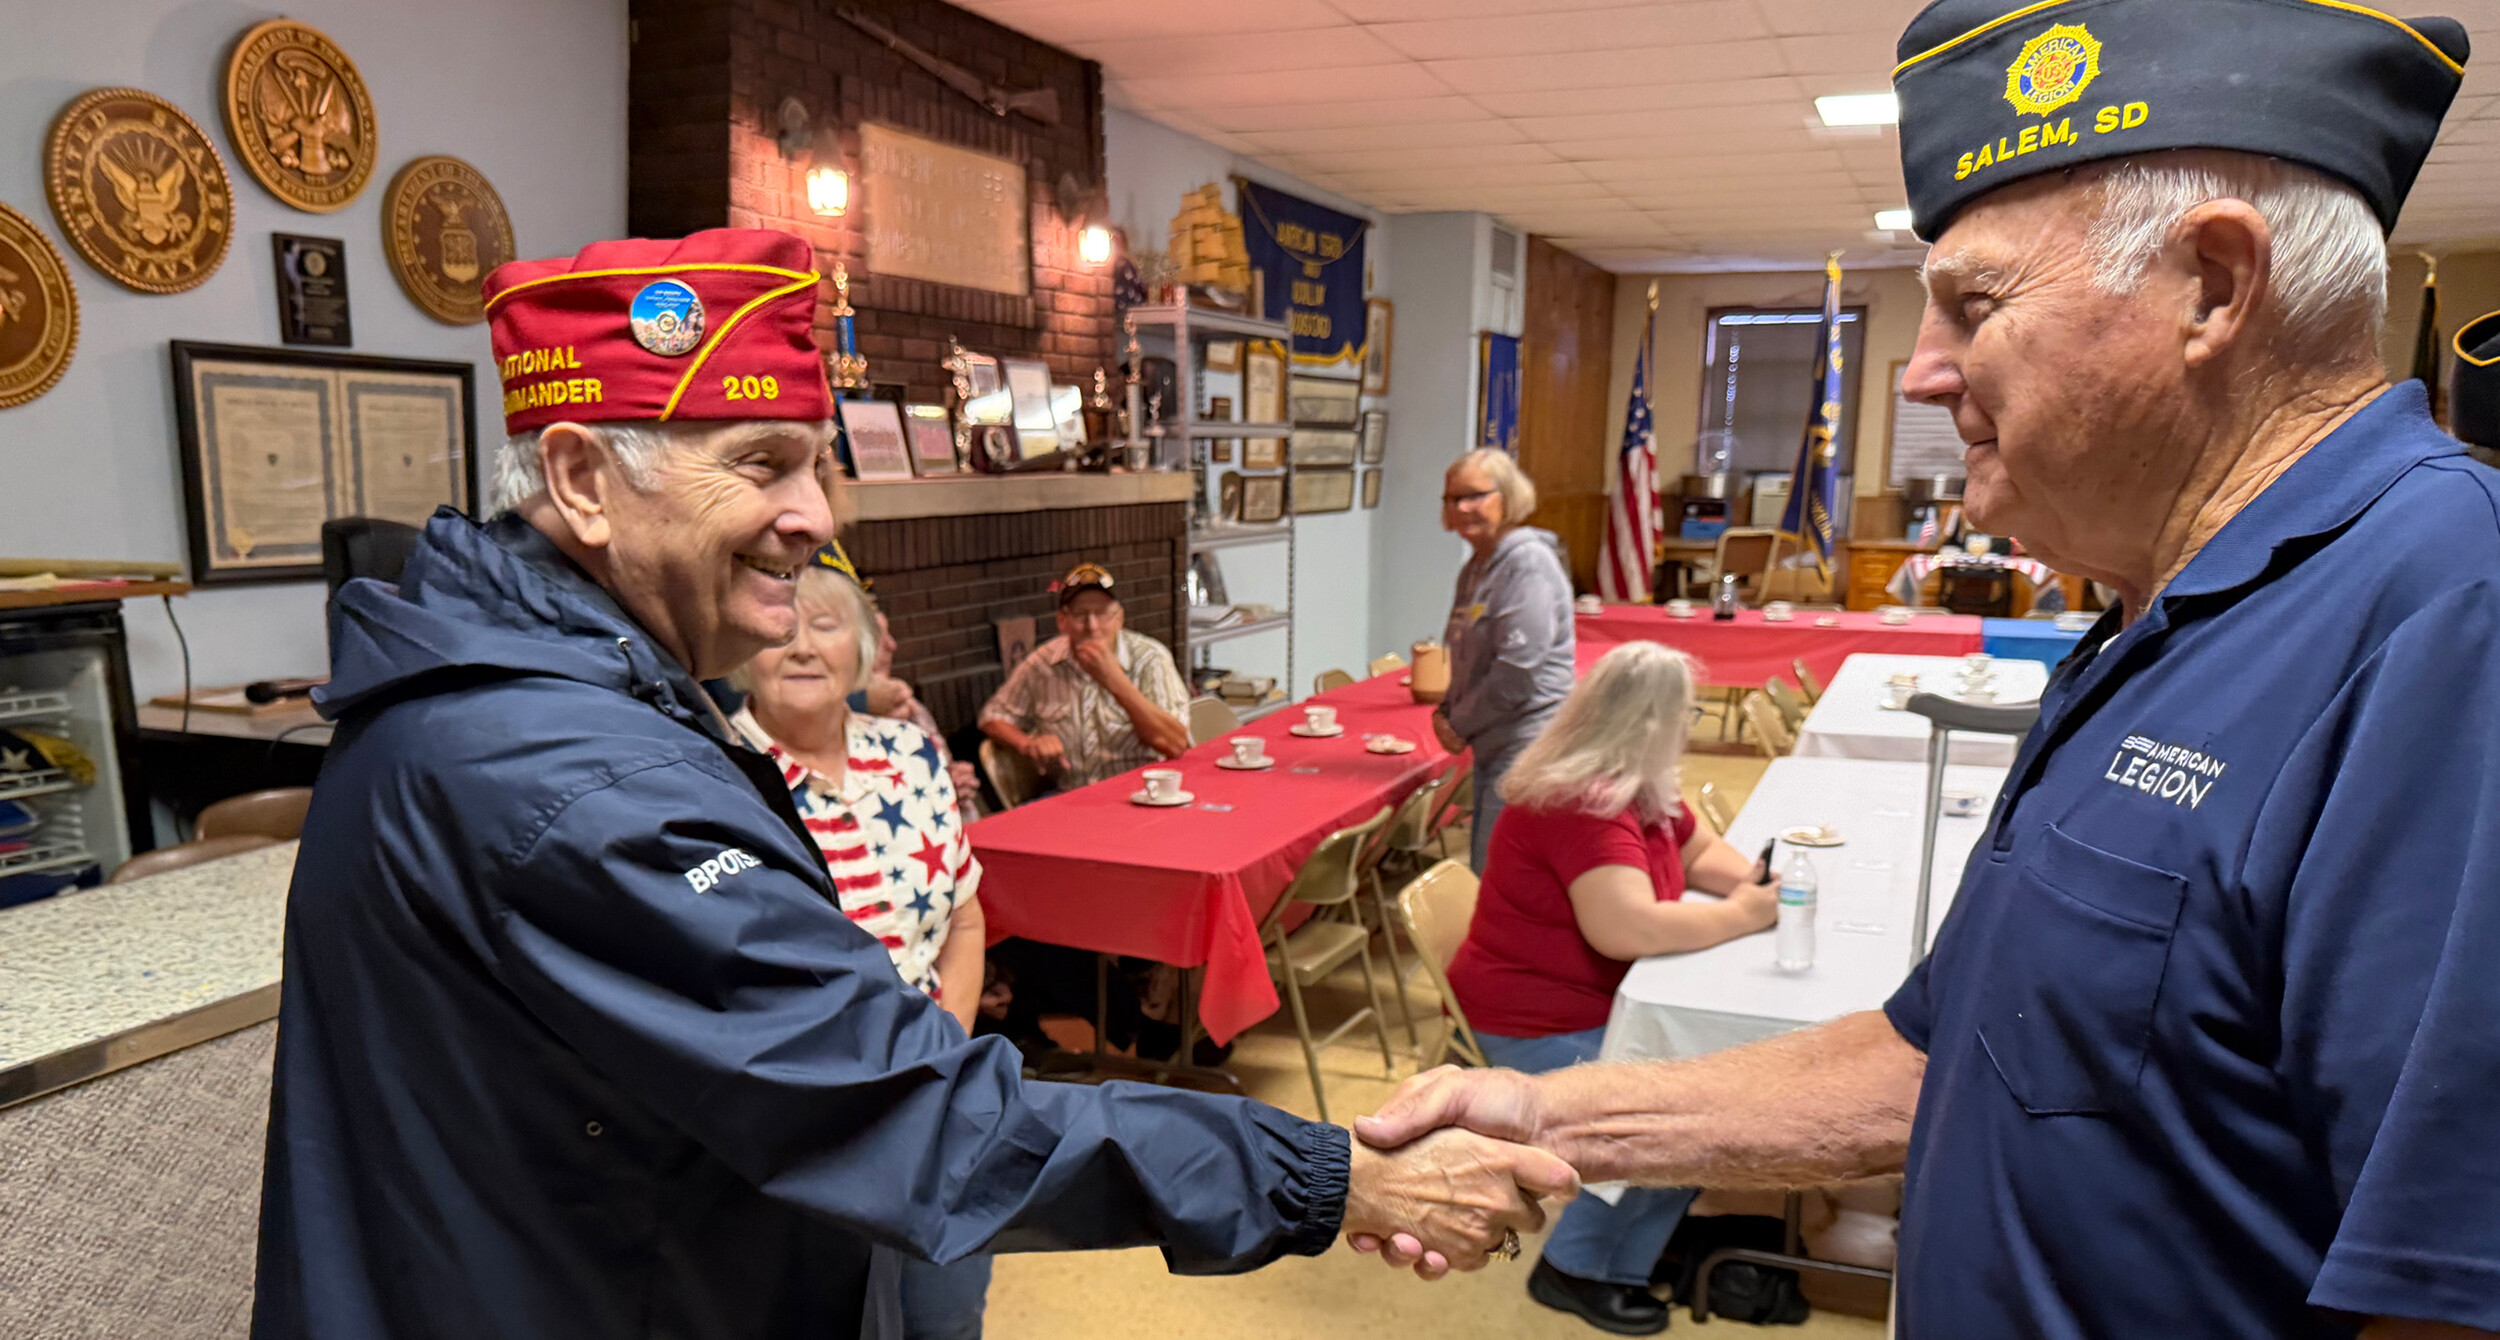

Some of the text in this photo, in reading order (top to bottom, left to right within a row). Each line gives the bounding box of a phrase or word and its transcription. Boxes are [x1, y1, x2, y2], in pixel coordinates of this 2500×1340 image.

[2022, 37, 2087, 77] AMERICAN
[2024, 80, 2076, 103] LEGION
[1954, 101, 2149, 181] SALEM, SD
[123, 252, 197, 280] NAVY
[722, 375, 779, 401] 209
[2147, 742, 2227, 779] AMERICAN
[2104, 751, 2214, 810] LEGION
[684, 848, 762, 894] BPOTS
